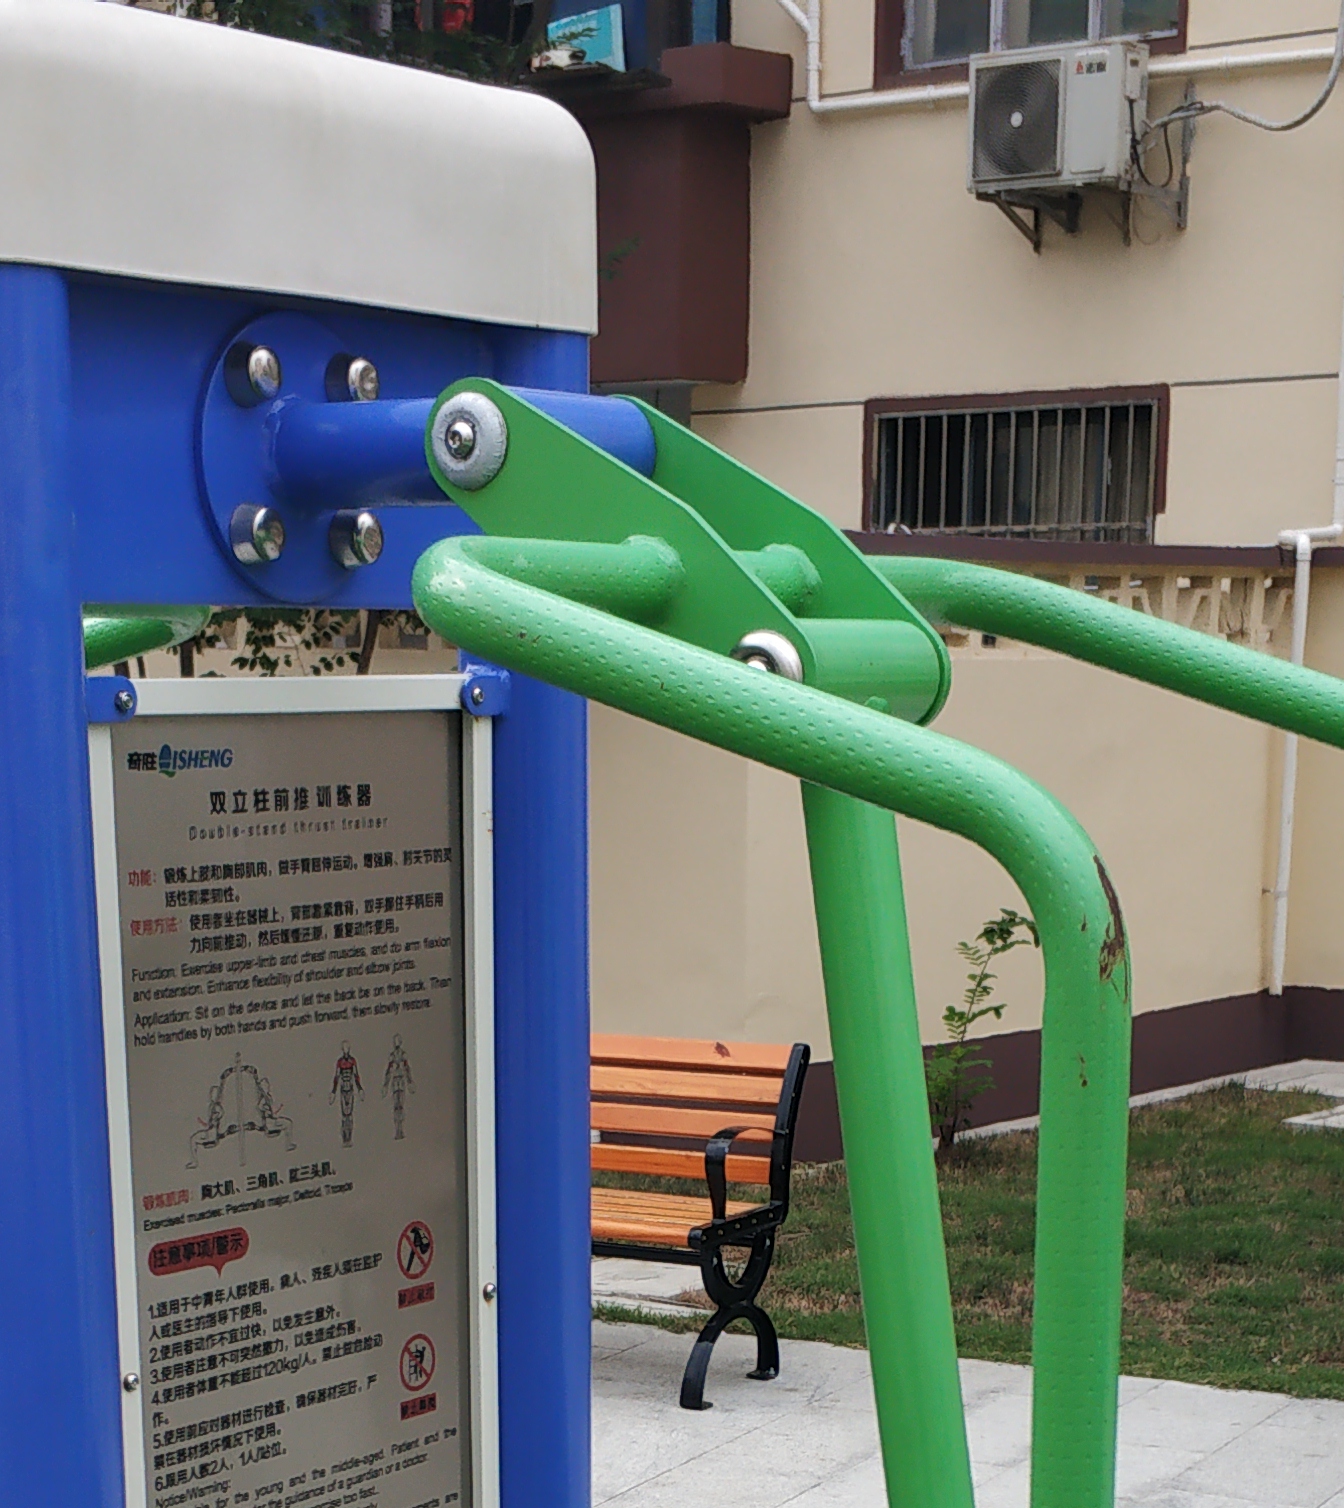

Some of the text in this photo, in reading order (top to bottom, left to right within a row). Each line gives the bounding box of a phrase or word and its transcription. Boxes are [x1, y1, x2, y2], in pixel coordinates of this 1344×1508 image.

[209, 783, 372, 815] 双立柱前推训练器
[279, 950, 298, 966] and
[369, 940, 387, 955] and
[131, 987, 152, 1003] and
[293, 969, 303, 983] of
[347, 962, 363, 976] and
[194, 1004, 209, 1020] Sit
[211, 1004, 225, 1018] on
[227, 999, 244, 1016] the
[246, 995, 277, 1013] device
[280, 992, 300, 1009] and
[315, 989, 330, 1004] the
[357, 984, 370, 998] be
[372, 984, 384, 996] on
[386, 980, 401, 995] the
[133, 1031, 156, 1048] hold
[157, 1026, 197, 1045] handles
[199, 1024, 212, 1042] by
[213, 1021, 235, 1037] both
[237, 1017, 266, 1033] hands
[268, 1014, 286, 1029] and
[288, 1011, 312, 1030] push
[234, 1488, 250, 1504] the
[254, 1480, 284, 1502] young
[288, 1471, 306, 1487] and
[311, 1465, 326, 1480] the
[423, 1430, 439, 1445] and
[442, 1425, 457, 1439] the
[326, 1479, 337, 1493] of
[337, 1479, 344, 1489] a
[345, 1464, 383, 1490] guardian
[384, 1464, 393, 1474] or
[394, 1461, 400, 1471] a
[343, 1489, 358, 1505] too
[444, 1491, 458, 1504] are
